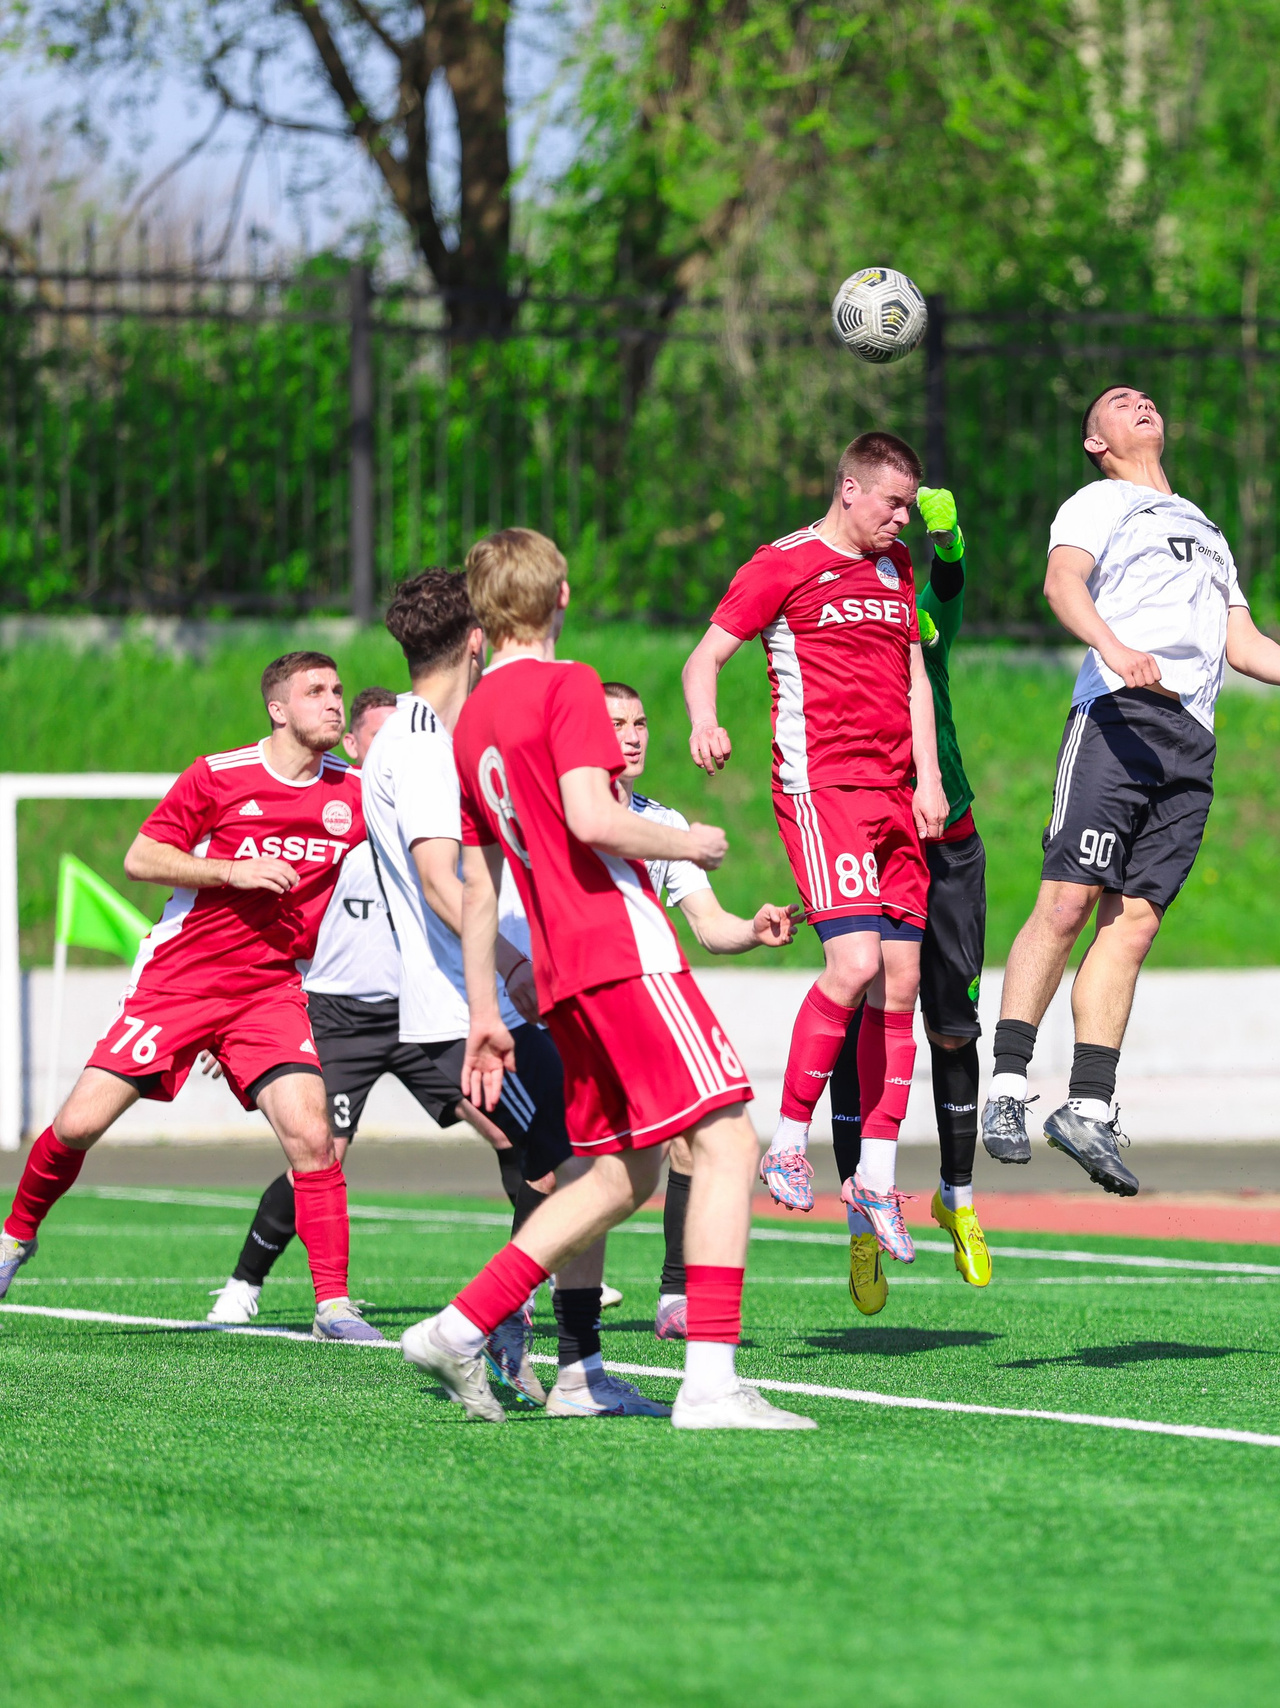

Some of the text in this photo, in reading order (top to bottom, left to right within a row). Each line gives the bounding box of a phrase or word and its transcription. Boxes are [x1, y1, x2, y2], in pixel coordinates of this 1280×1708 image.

[817, 598, 910, 627] ASSET
[478, 745, 532, 870] 8
[234, 836, 350, 865] ASSET
[1079, 828, 1116, 868] 90
[835, 851, 880, 898] 88
[110, 1015, 163, 1065] 76
[884, 1076, 913, 1086] JÖG
[333, 1093, 351, 1128] 3
[832, 1113, 861, 1122] JÖGE
